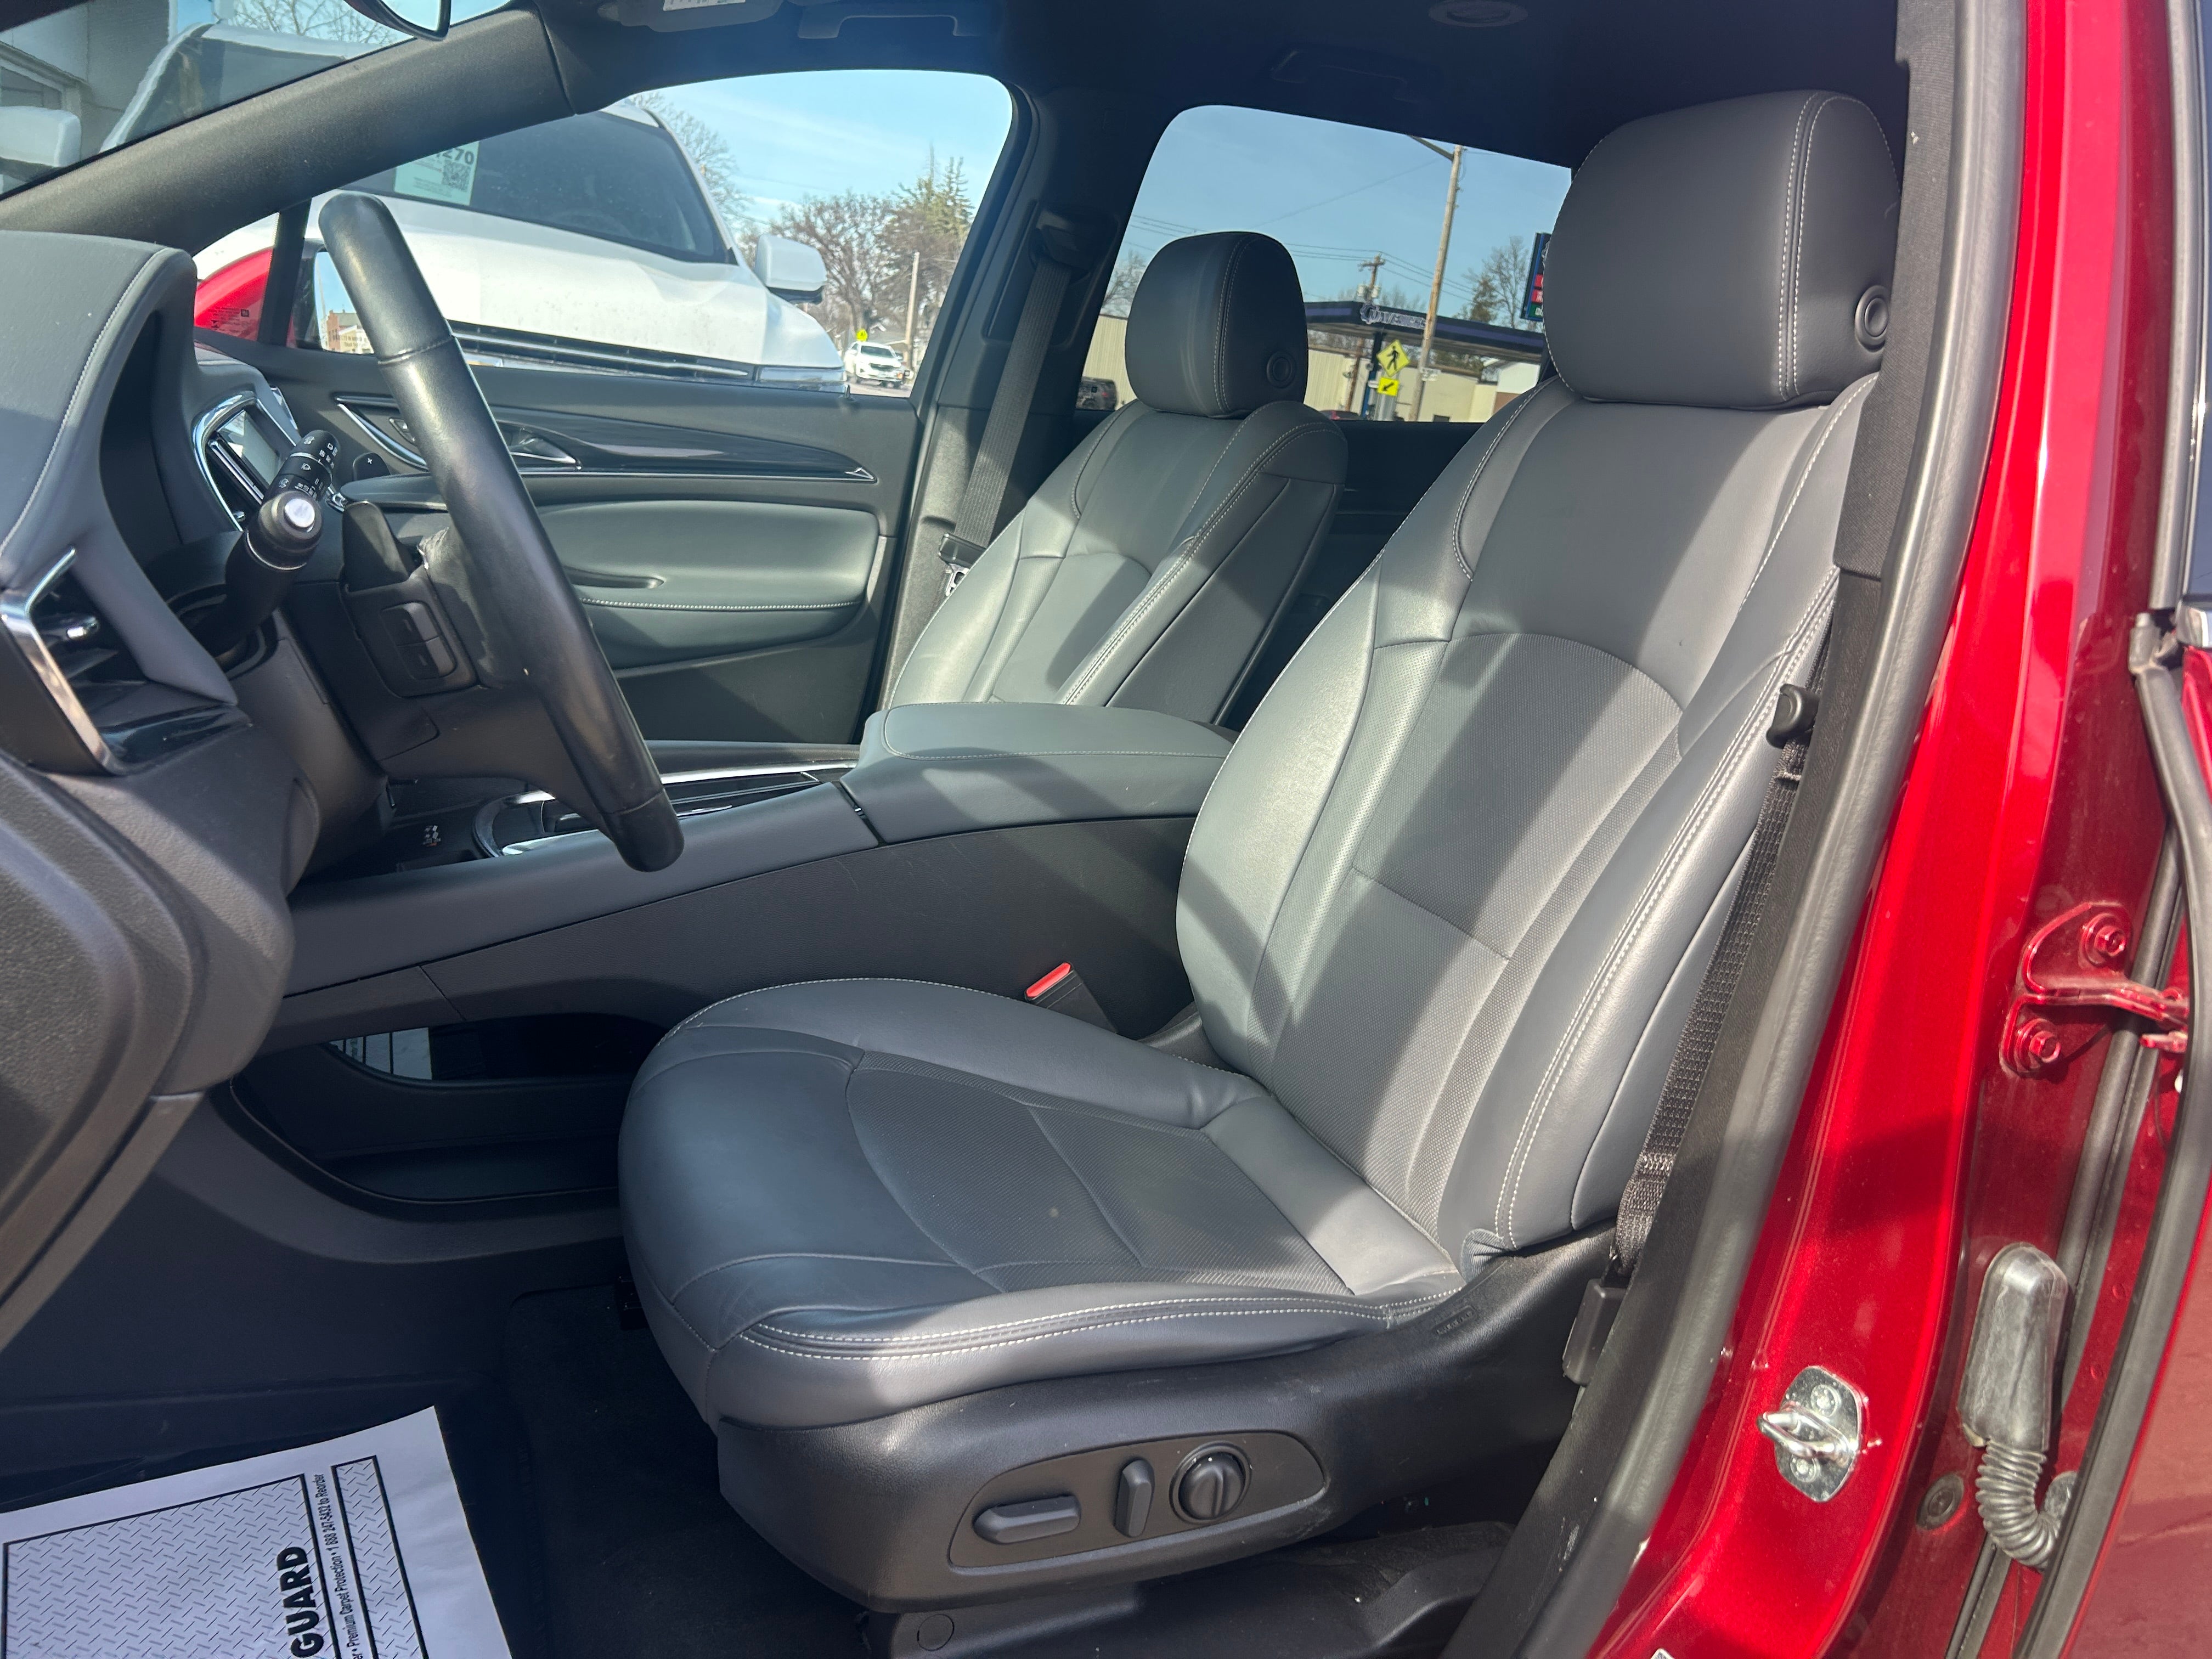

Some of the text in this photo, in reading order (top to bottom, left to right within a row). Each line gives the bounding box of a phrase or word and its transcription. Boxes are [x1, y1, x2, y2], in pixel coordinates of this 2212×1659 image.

[436, 148, 474, 165] 270
[312, 1474, 328, 1498] Reorder
[318, 1497, 330, 1505] to
[330, 1555, 348, 1592] Protection
[276, 1547, 324, 1658] GUARD
[336, 1592, 354, 1615] Carpet
[342, 1614, 360, 1647] Premium
